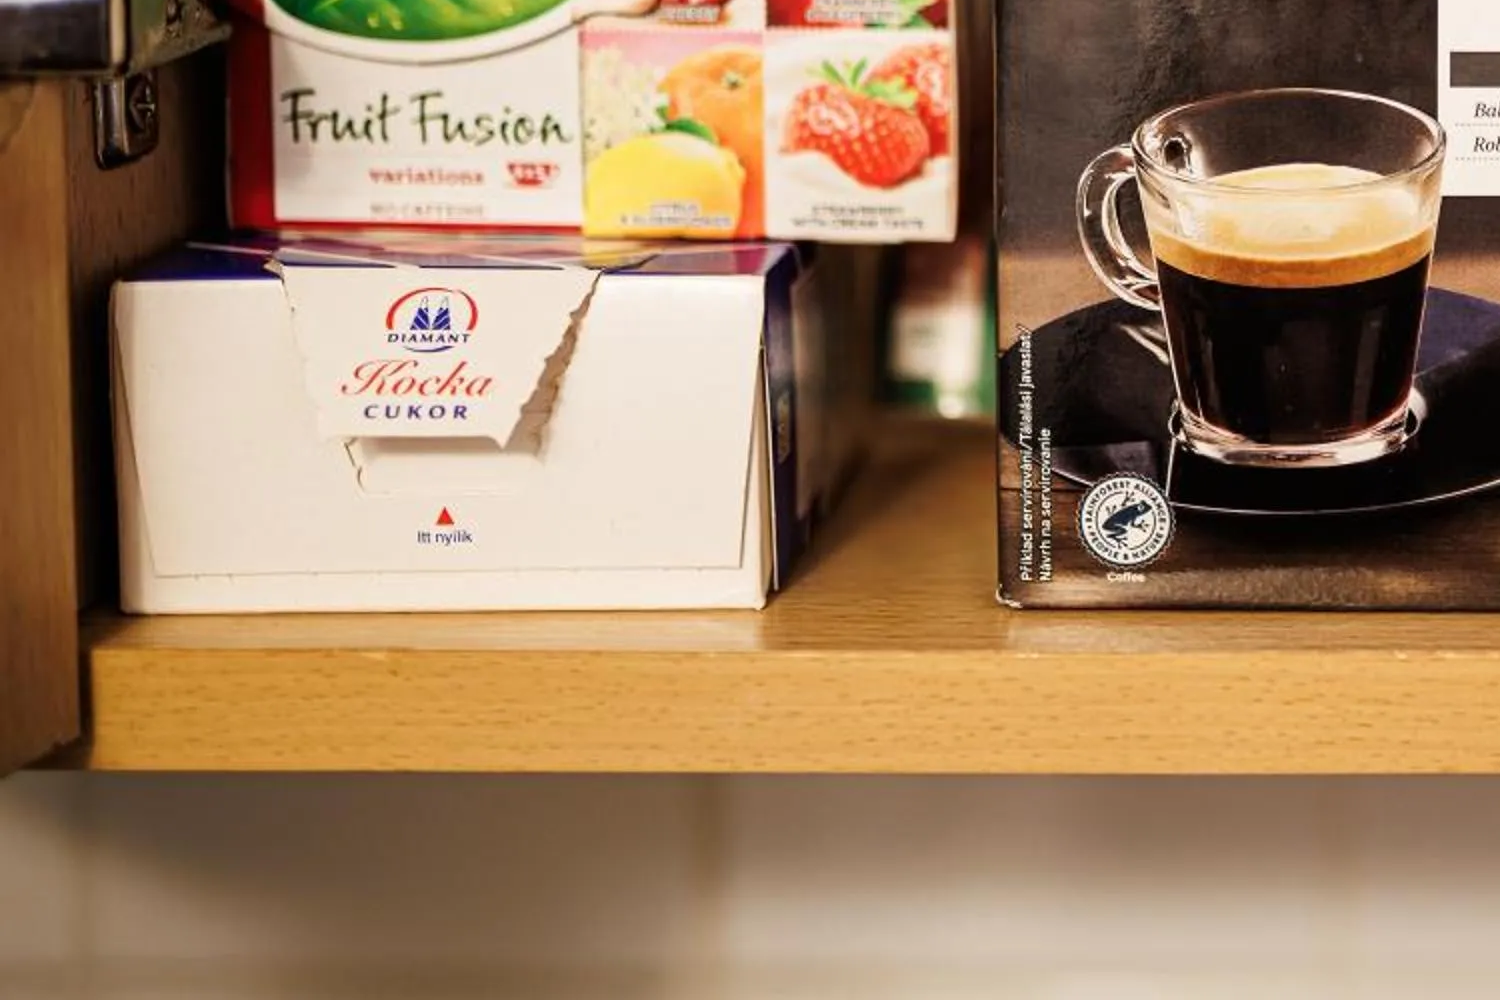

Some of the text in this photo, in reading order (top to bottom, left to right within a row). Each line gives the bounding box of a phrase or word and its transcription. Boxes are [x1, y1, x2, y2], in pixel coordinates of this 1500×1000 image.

[281, 87, 573, 145] Fruit Fusion
[369, 167, 485, 185] variations
[387, 333, 471, 344] DIAMANT
[340, 359, 494, 397] Kocka
[363, 404, 468, 420] CUKOR
[1085, 480, 1167, 523] RAINFOREST ALLIANCE
[417, 531, 431, 543] Itt
[1041, 520, 1051, 537] na
[1089, 531, 1120, 561] PEOPLE
[1132, 531, 1165, 558] NATURE
